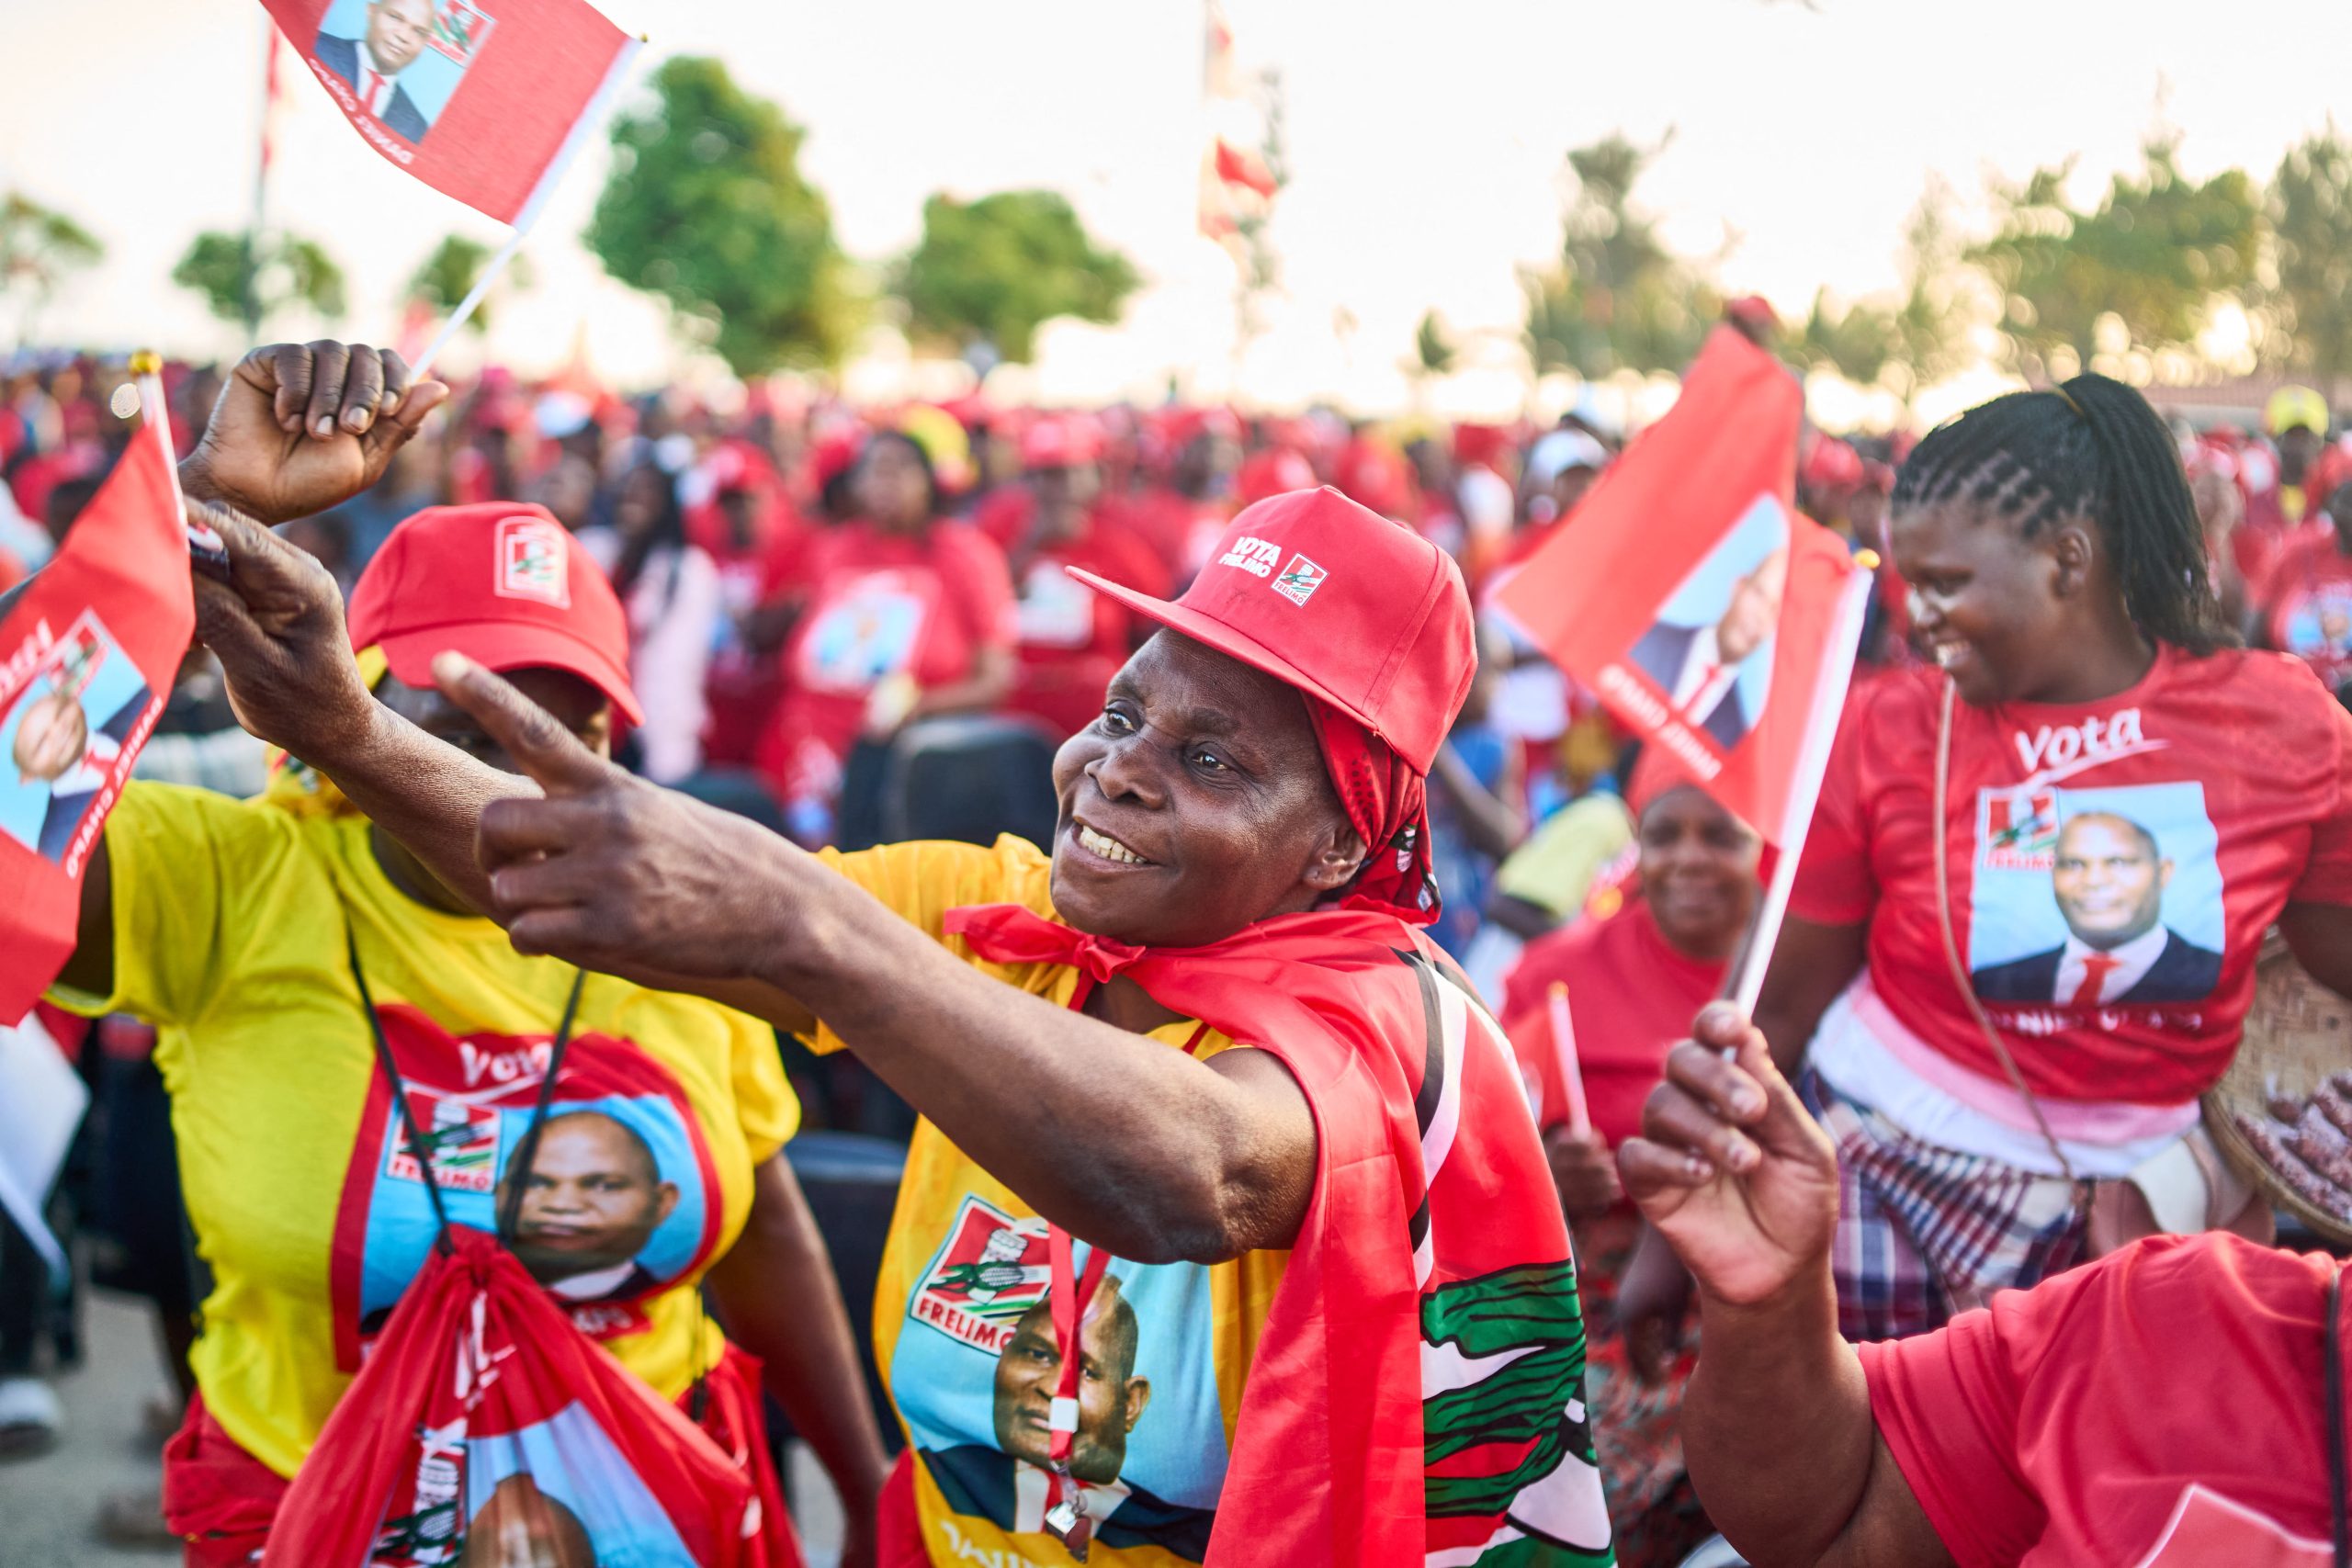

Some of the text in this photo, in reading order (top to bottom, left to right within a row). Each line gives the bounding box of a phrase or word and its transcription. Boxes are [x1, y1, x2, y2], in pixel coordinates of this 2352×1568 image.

[1218, 552, 1272, 578] FRELIMO
[1274, 581, 1305, 604] FRELIMO
[2014, 706, 2144, 773] Vota
